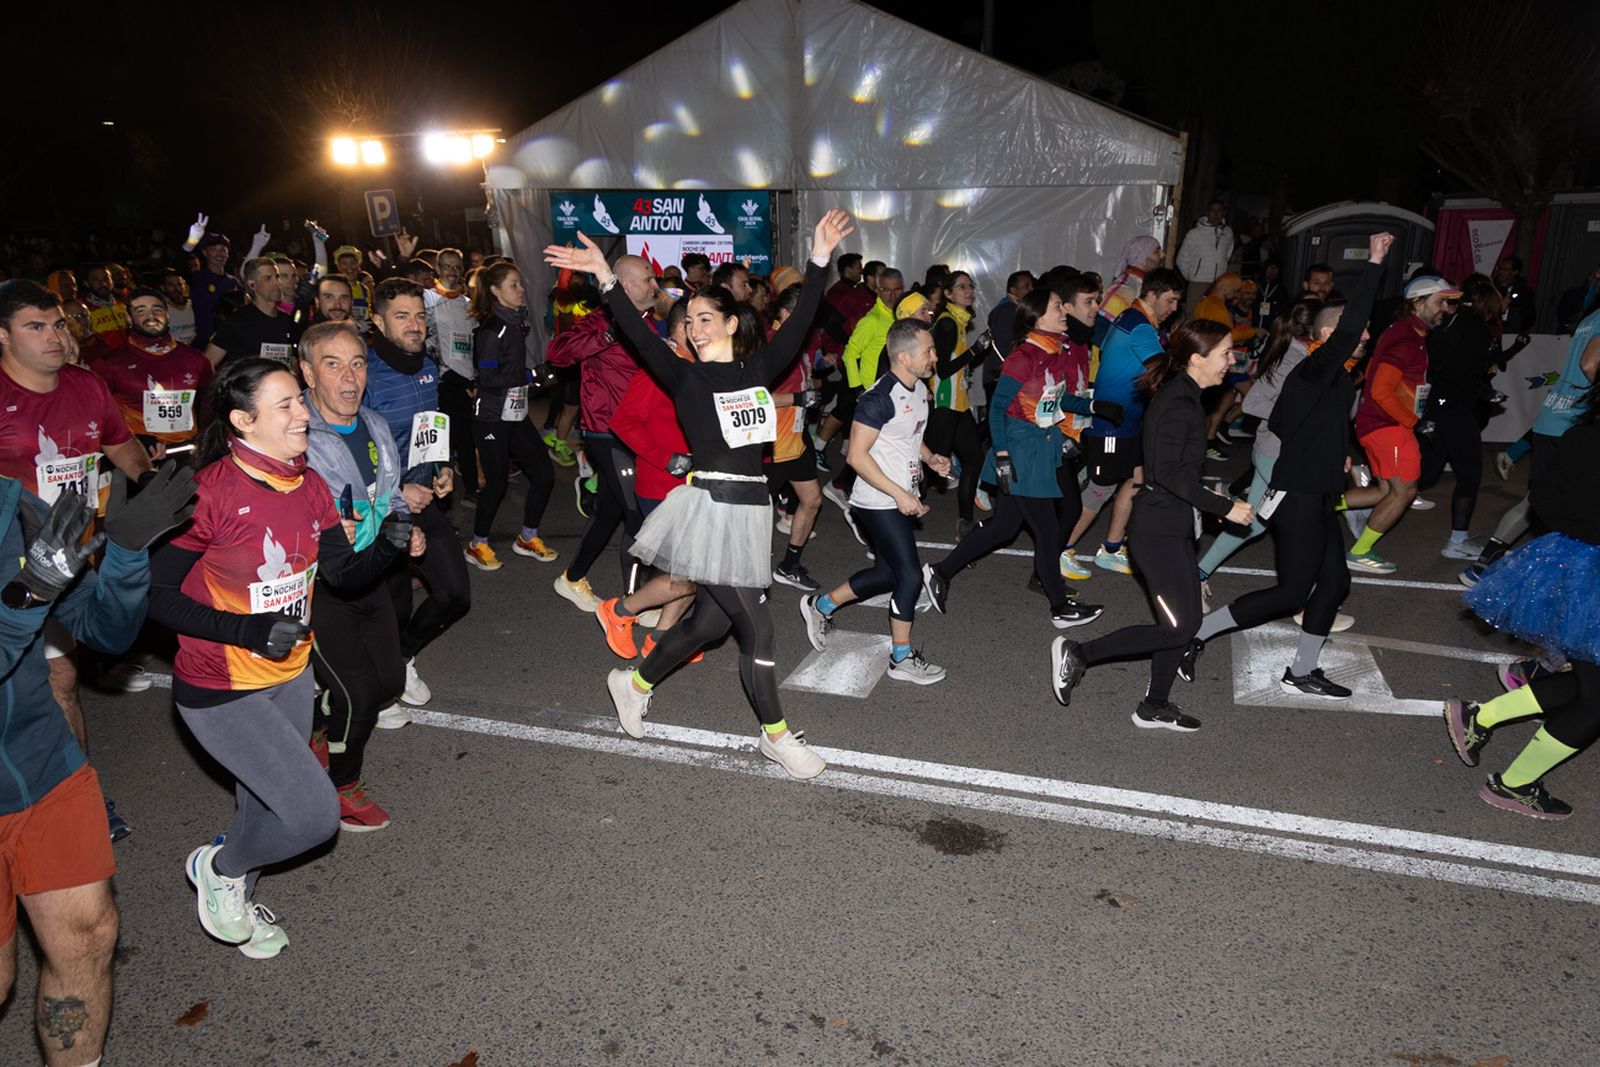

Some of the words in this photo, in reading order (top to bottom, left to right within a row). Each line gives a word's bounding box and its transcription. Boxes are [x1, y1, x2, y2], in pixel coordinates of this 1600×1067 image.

[632, 198, 653, 214] 43
[653, 198, 685, 214] SAN
[372, 195, 391, 231] P
[601, 216, 611, 228] 43
[630, 212, 683, 231] ANTÓN
[705, 216, 715, 228] 43
[158, 405, 183, 419] 559
[730, 407, 766, 428] 3079
[55, 464, 78, 474] NOCHE
[47, 475, 63, 484] SAN
[274, 585, 297, 596] NOCHE
[264, 597, 281, 608] SAN
